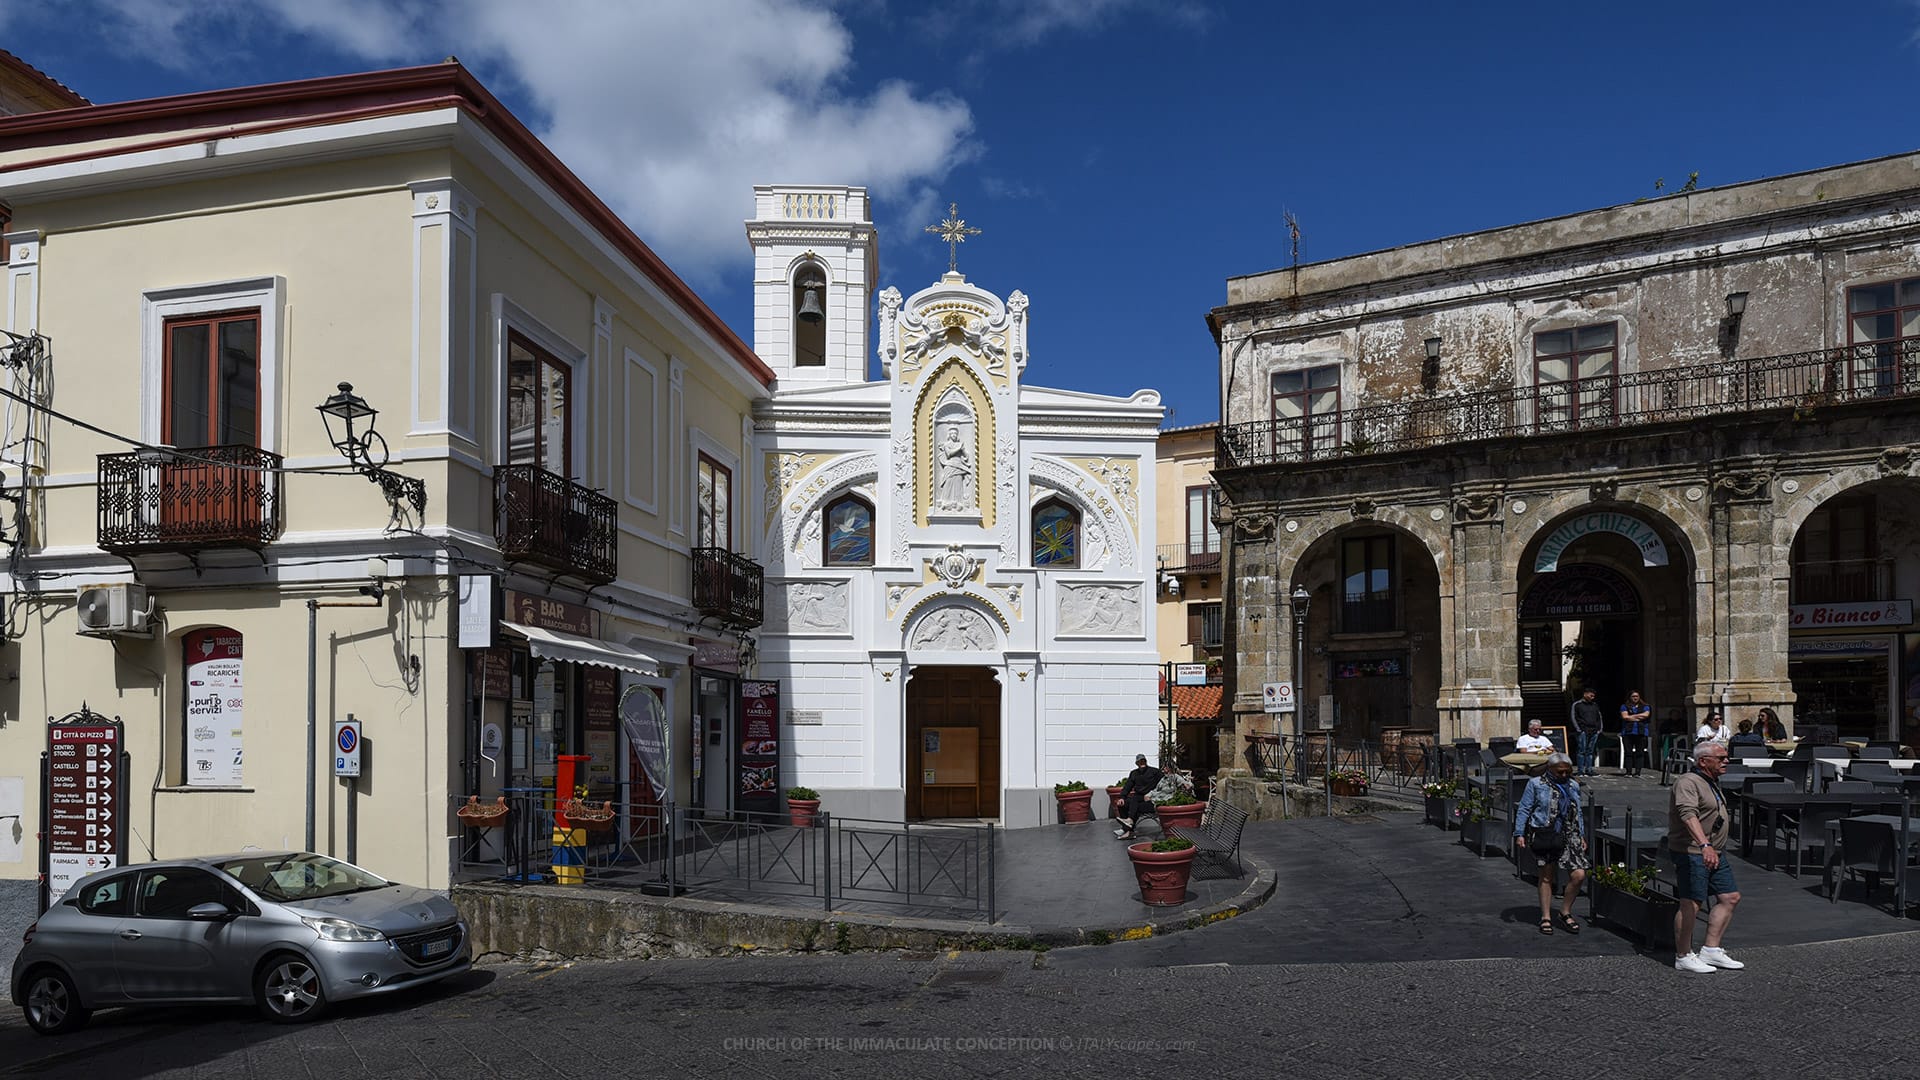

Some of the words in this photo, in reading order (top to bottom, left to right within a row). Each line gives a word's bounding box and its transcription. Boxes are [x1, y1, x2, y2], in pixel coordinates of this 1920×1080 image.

[1642, 539, 1660, 553] TINA
[540, 599, 565, 620] BAR
[1812, 607, 1881, 624] Bianco
